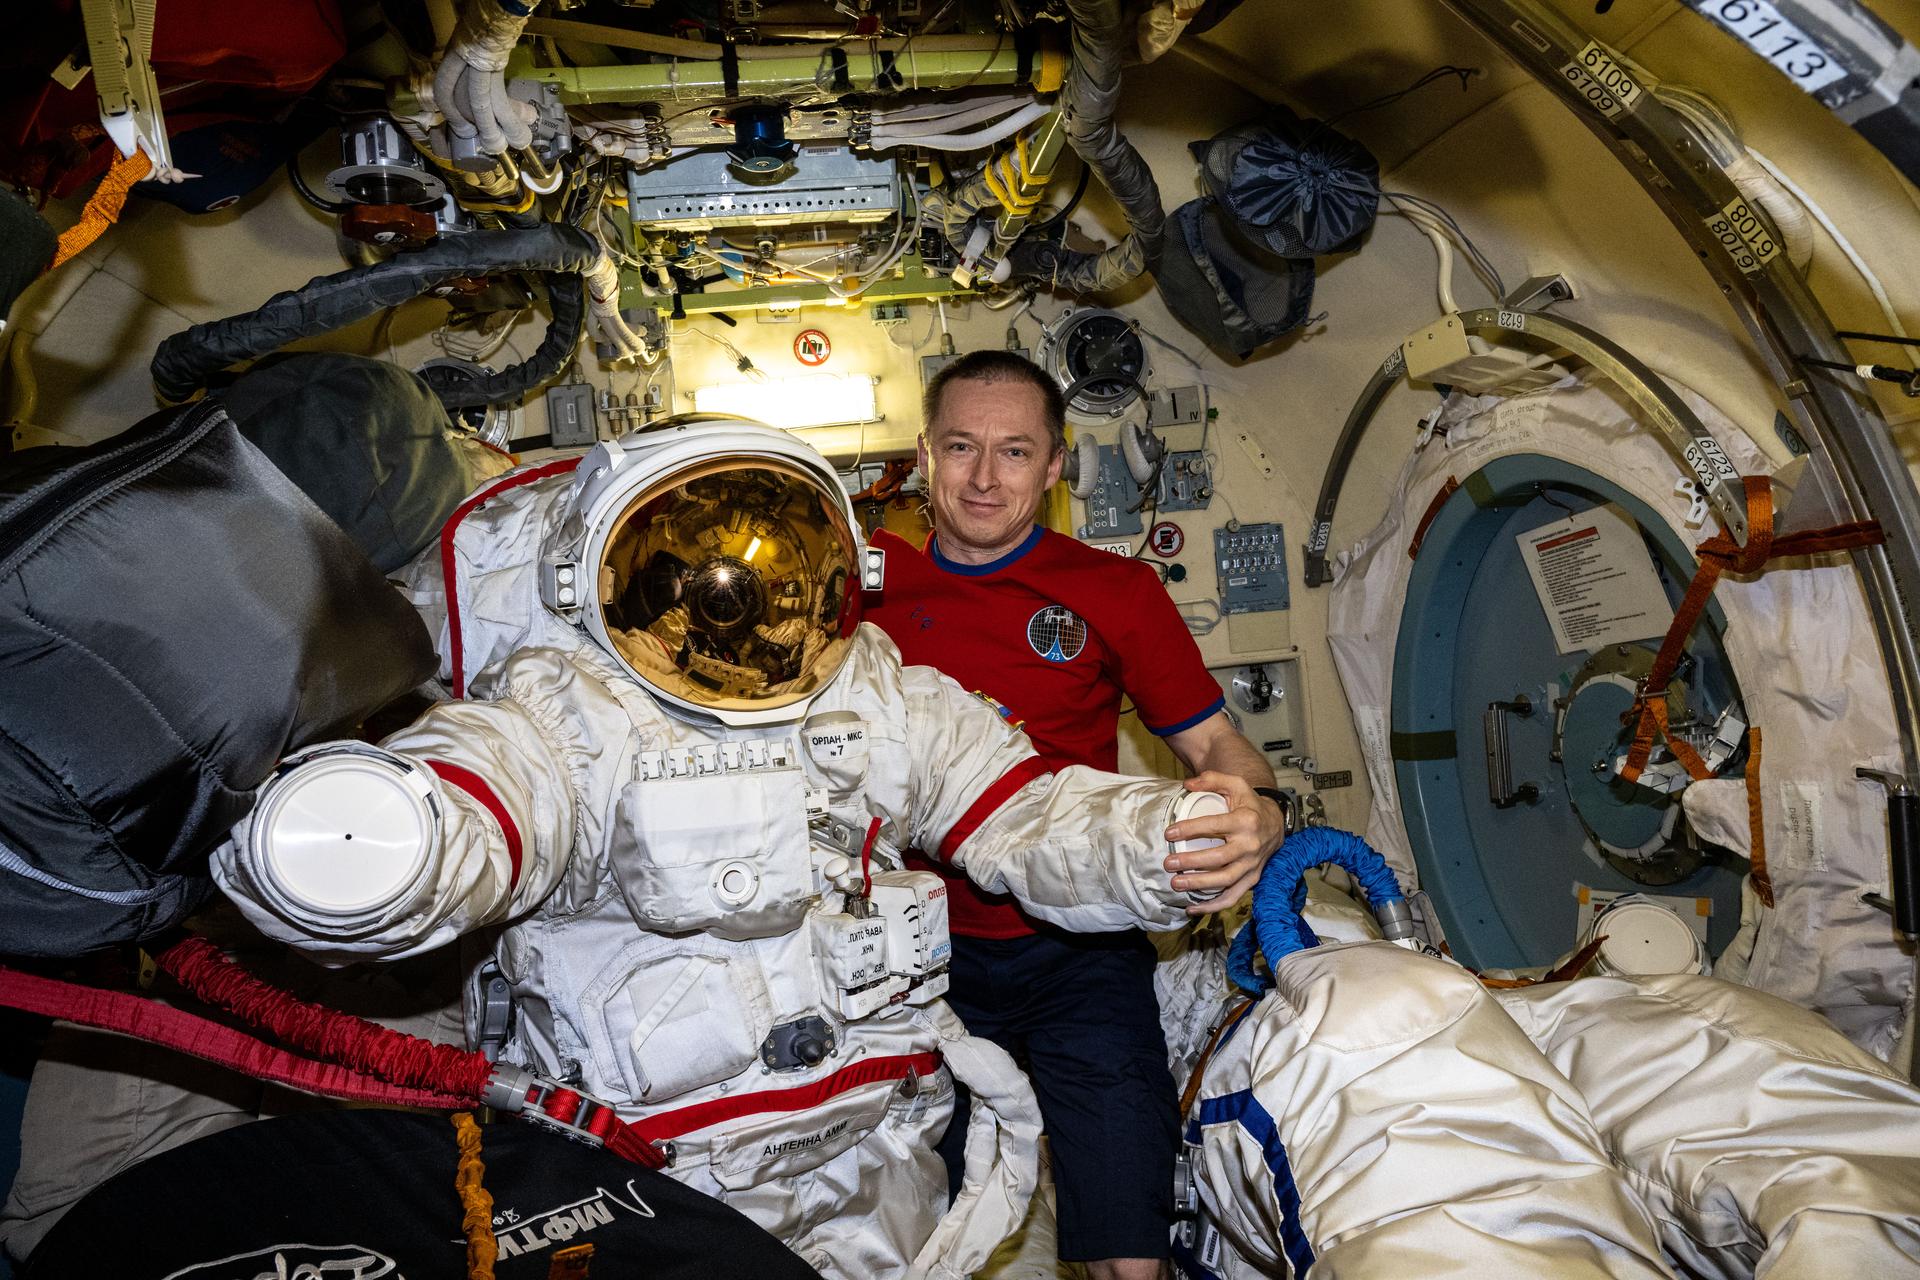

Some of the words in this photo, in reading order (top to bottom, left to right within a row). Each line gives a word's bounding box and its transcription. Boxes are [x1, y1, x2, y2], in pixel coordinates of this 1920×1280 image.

[1720, 0, 1827, 78] 6113
[1565, 66, 1614, 111] 6109
[1584, 47, 1633, 98] 6109
[1711, 220, 1754, 268] 6108
[1730, 204, 1774, 257] 6108
[1500, 312, 1523, 329] 6123
[1686, 446, 1715, 487] 6123
[1699, 439, 1733, 475] 6123
[1317, 523, 1330, 547] 6124
[1051, 652, 1061, 661] 73
[812, 734, 842, 746] ОРЛАН
[847, 731, 863, 742] МКС
[837, 744, 844, 756] 7
[762, 1134, 822, 1156] АНТЕННА
[824, 1120, 849, 1140] АММ
